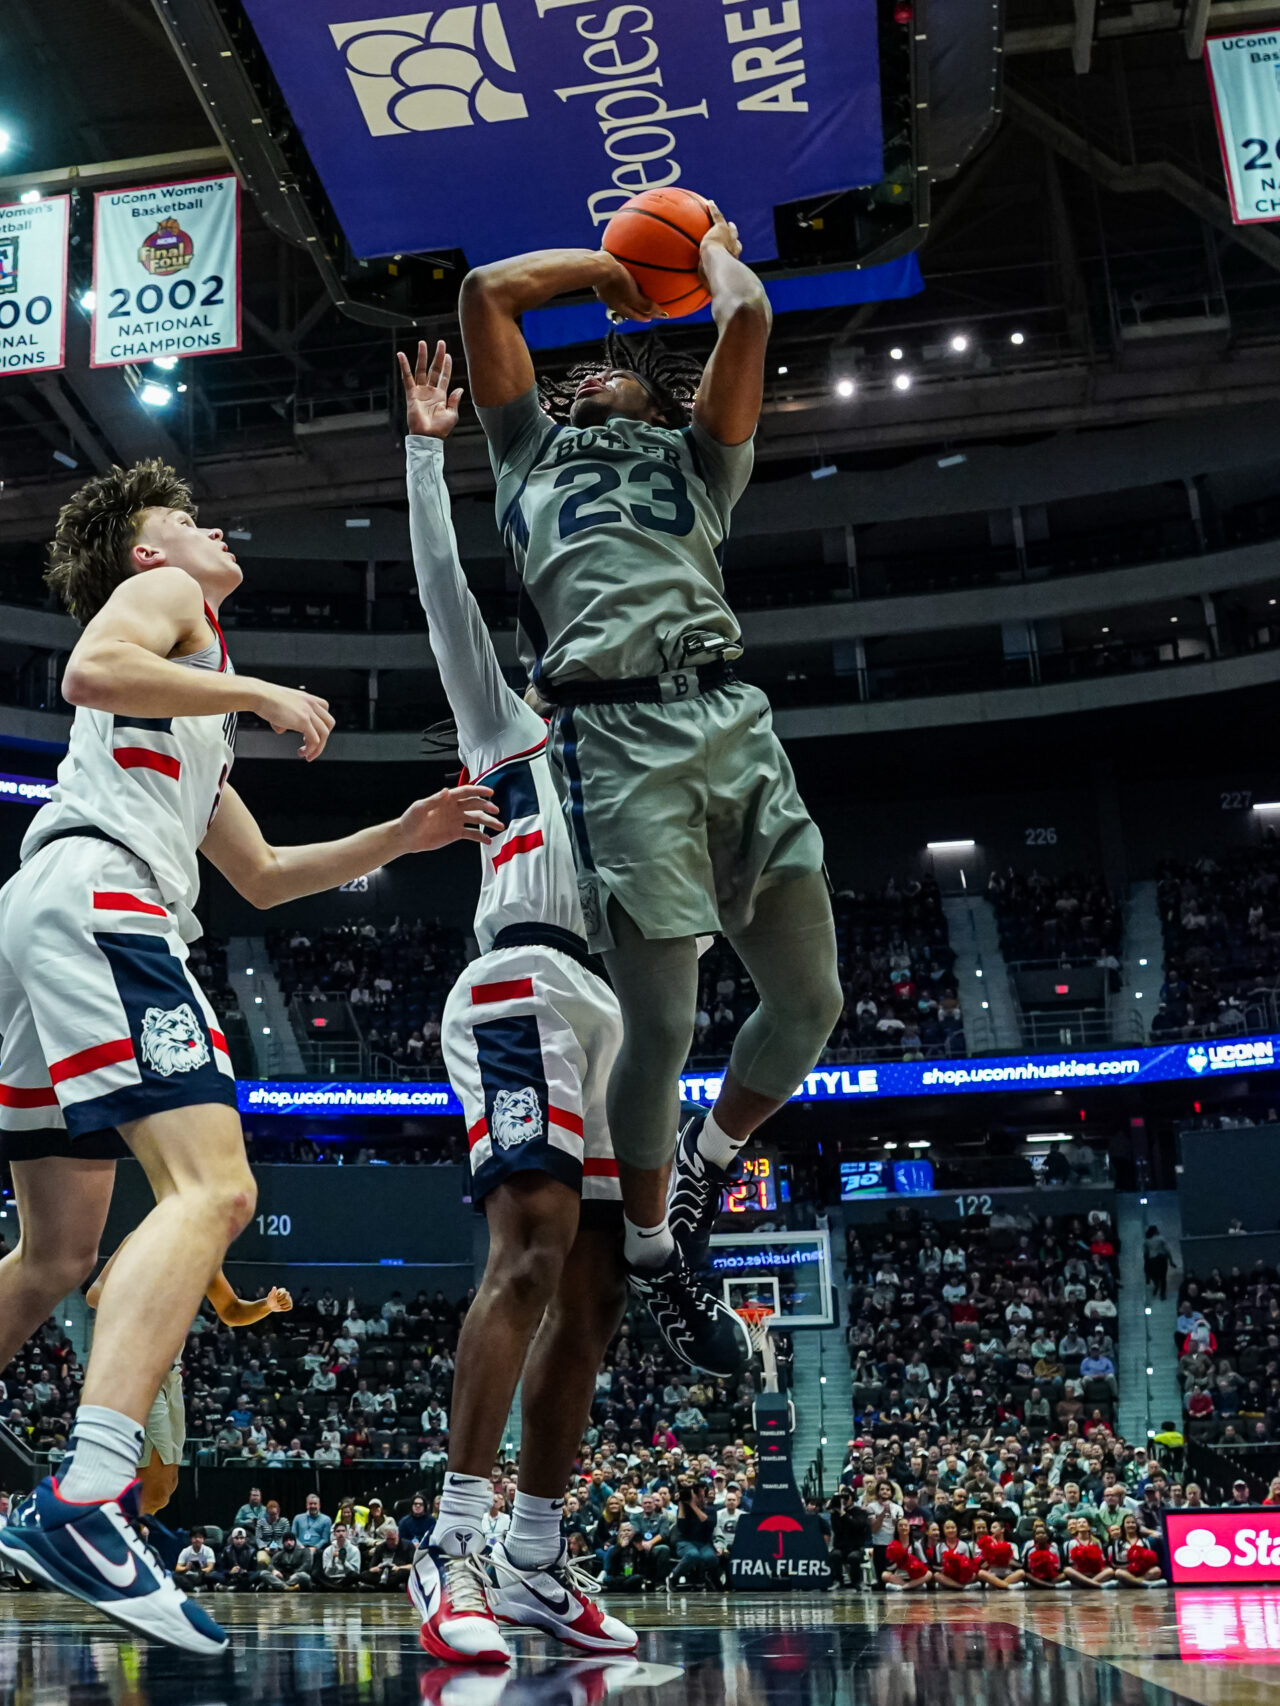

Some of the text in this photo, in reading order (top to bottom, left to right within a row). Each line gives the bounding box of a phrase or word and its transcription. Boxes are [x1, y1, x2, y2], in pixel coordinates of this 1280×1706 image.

[1222, 36, 1277, 51] UConn
[553, 4, 709, 227] Peoples
[111, 182, 224, 206] UConn Women's
[1261, 178, 1280, 191] N
[131, 199, 203, 218] Basketball
[139, 242, 185, 262] Final
[149, 254, 194, 273] Four
[108, 275, 224, 319] 2002
[119, 315, 213, 337] NATIONAL
[111, 332, 221, 357] CHAMPIONS
[554, 430, 682, 472] BUTER
[553, 461, 696, 540] 23
[672, 674, 689, 696] B
[1221, 791, 1252, 809] 227
[1025, 828, 1057, 845] 226
[1208, 1041, 1274, 1062] UCONN
[792, 1069, 879, 1096] TYLE
[922, 1060, 1140, 1086] shop.uconnhuskies.com
[248, 1088, 449, 1107] shop.uconnhuskies.com
[728, 1179, 767, 1212] 21
[955, 1195, 993, 1217] 122
[256, 1214, 291, 1236] 120
